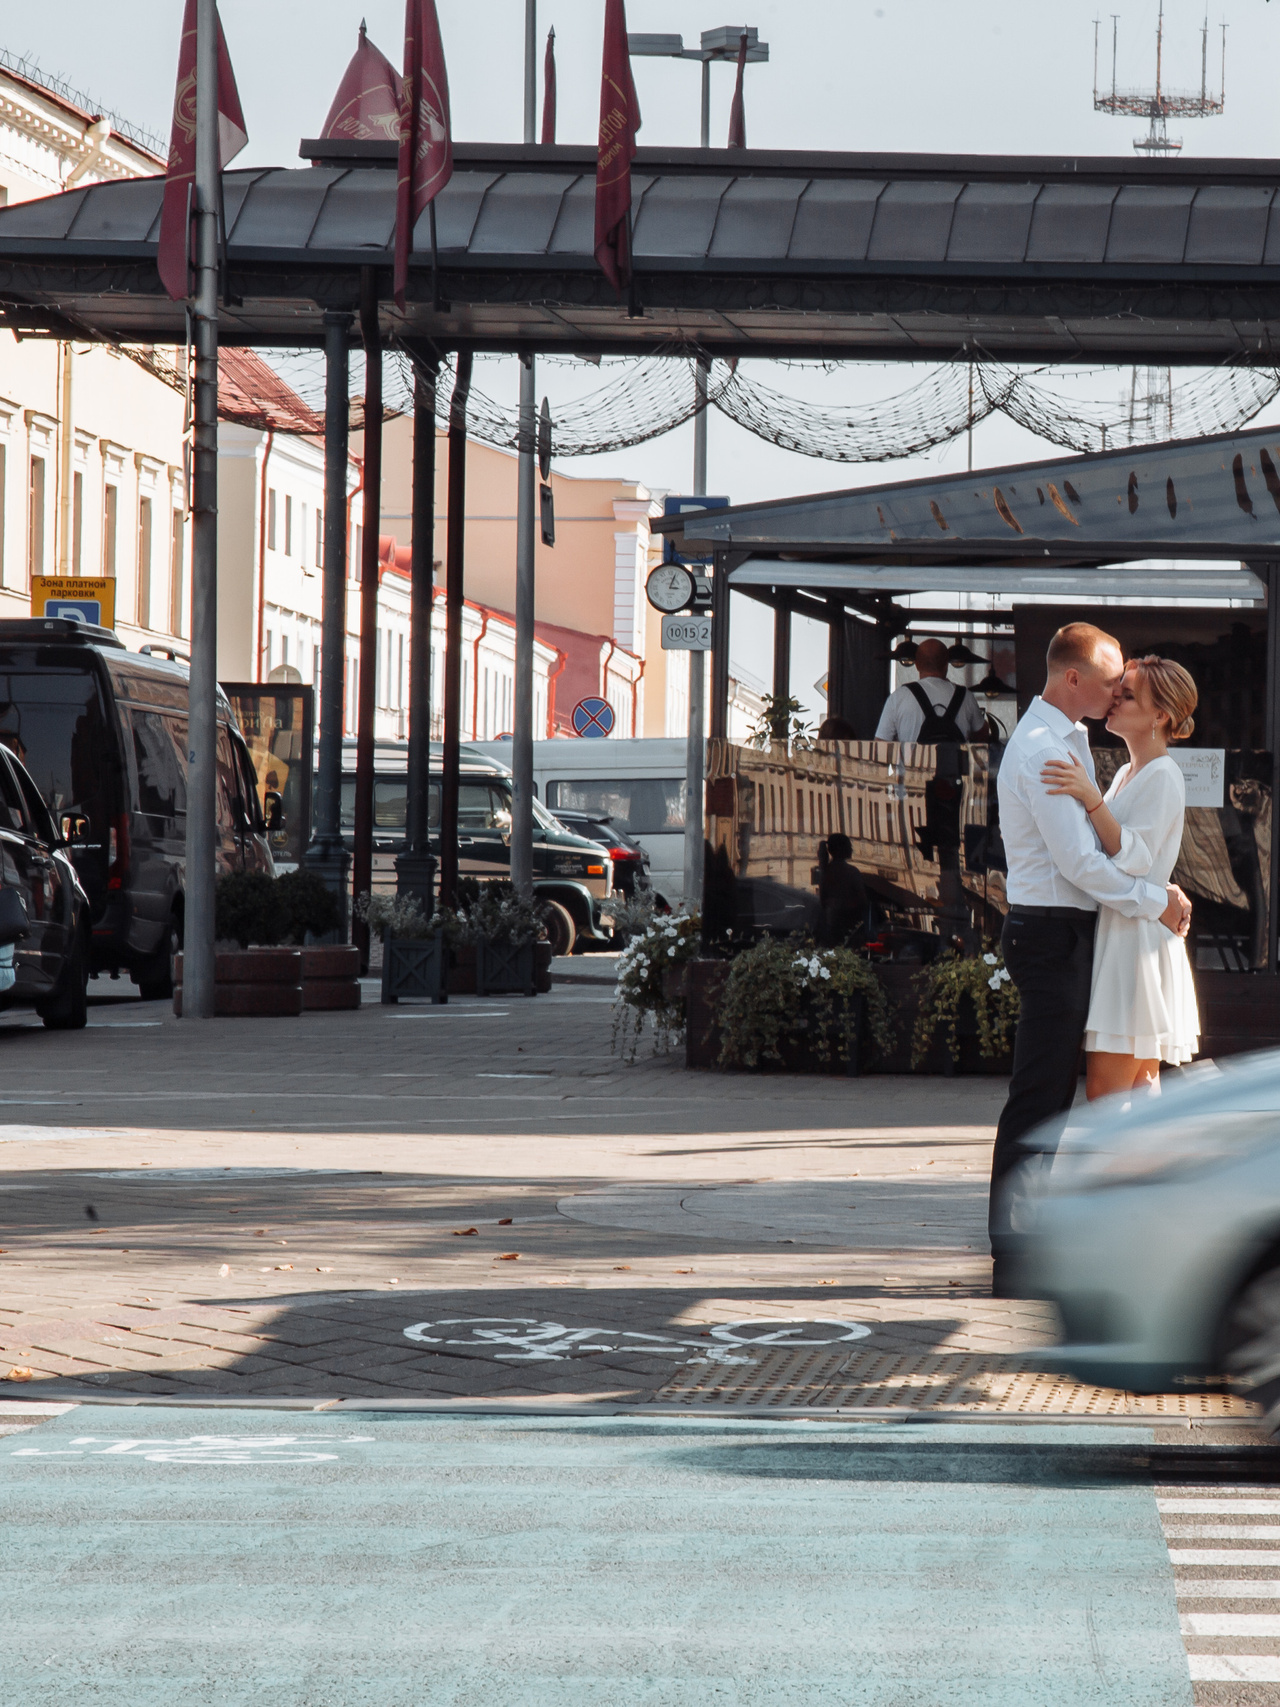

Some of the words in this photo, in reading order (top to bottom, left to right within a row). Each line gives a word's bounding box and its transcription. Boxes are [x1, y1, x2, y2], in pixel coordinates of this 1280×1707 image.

[40, 578, 63, 588] Зона
[66, 580, 106, 589] платной
[50, 589, 96, 598] парковки
[669, 627, 682, 638] 10
[684, 627, 696, 638] 15
